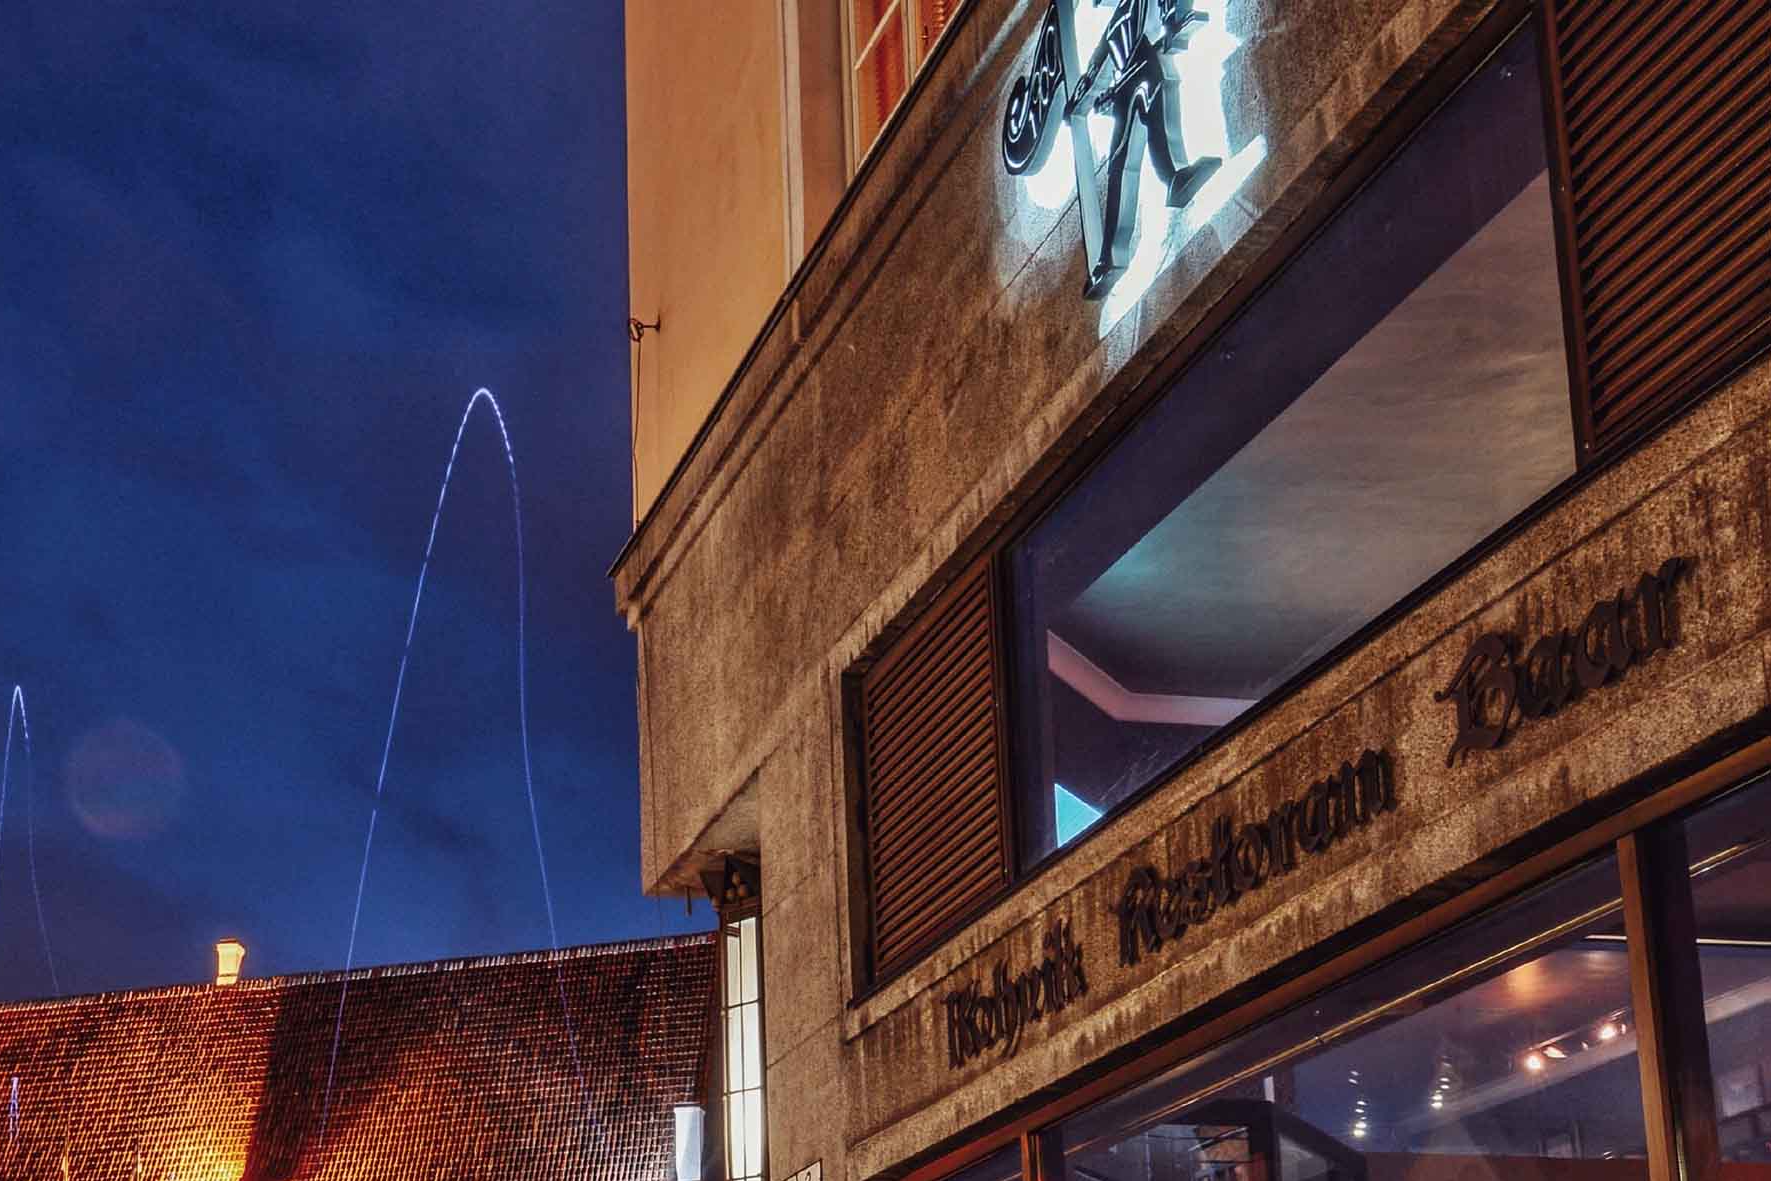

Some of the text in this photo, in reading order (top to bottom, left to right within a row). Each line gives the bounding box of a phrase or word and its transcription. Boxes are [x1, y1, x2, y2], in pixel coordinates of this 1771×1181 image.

[942, 556, 1696, 1070] Kohvik Restoran Baar
